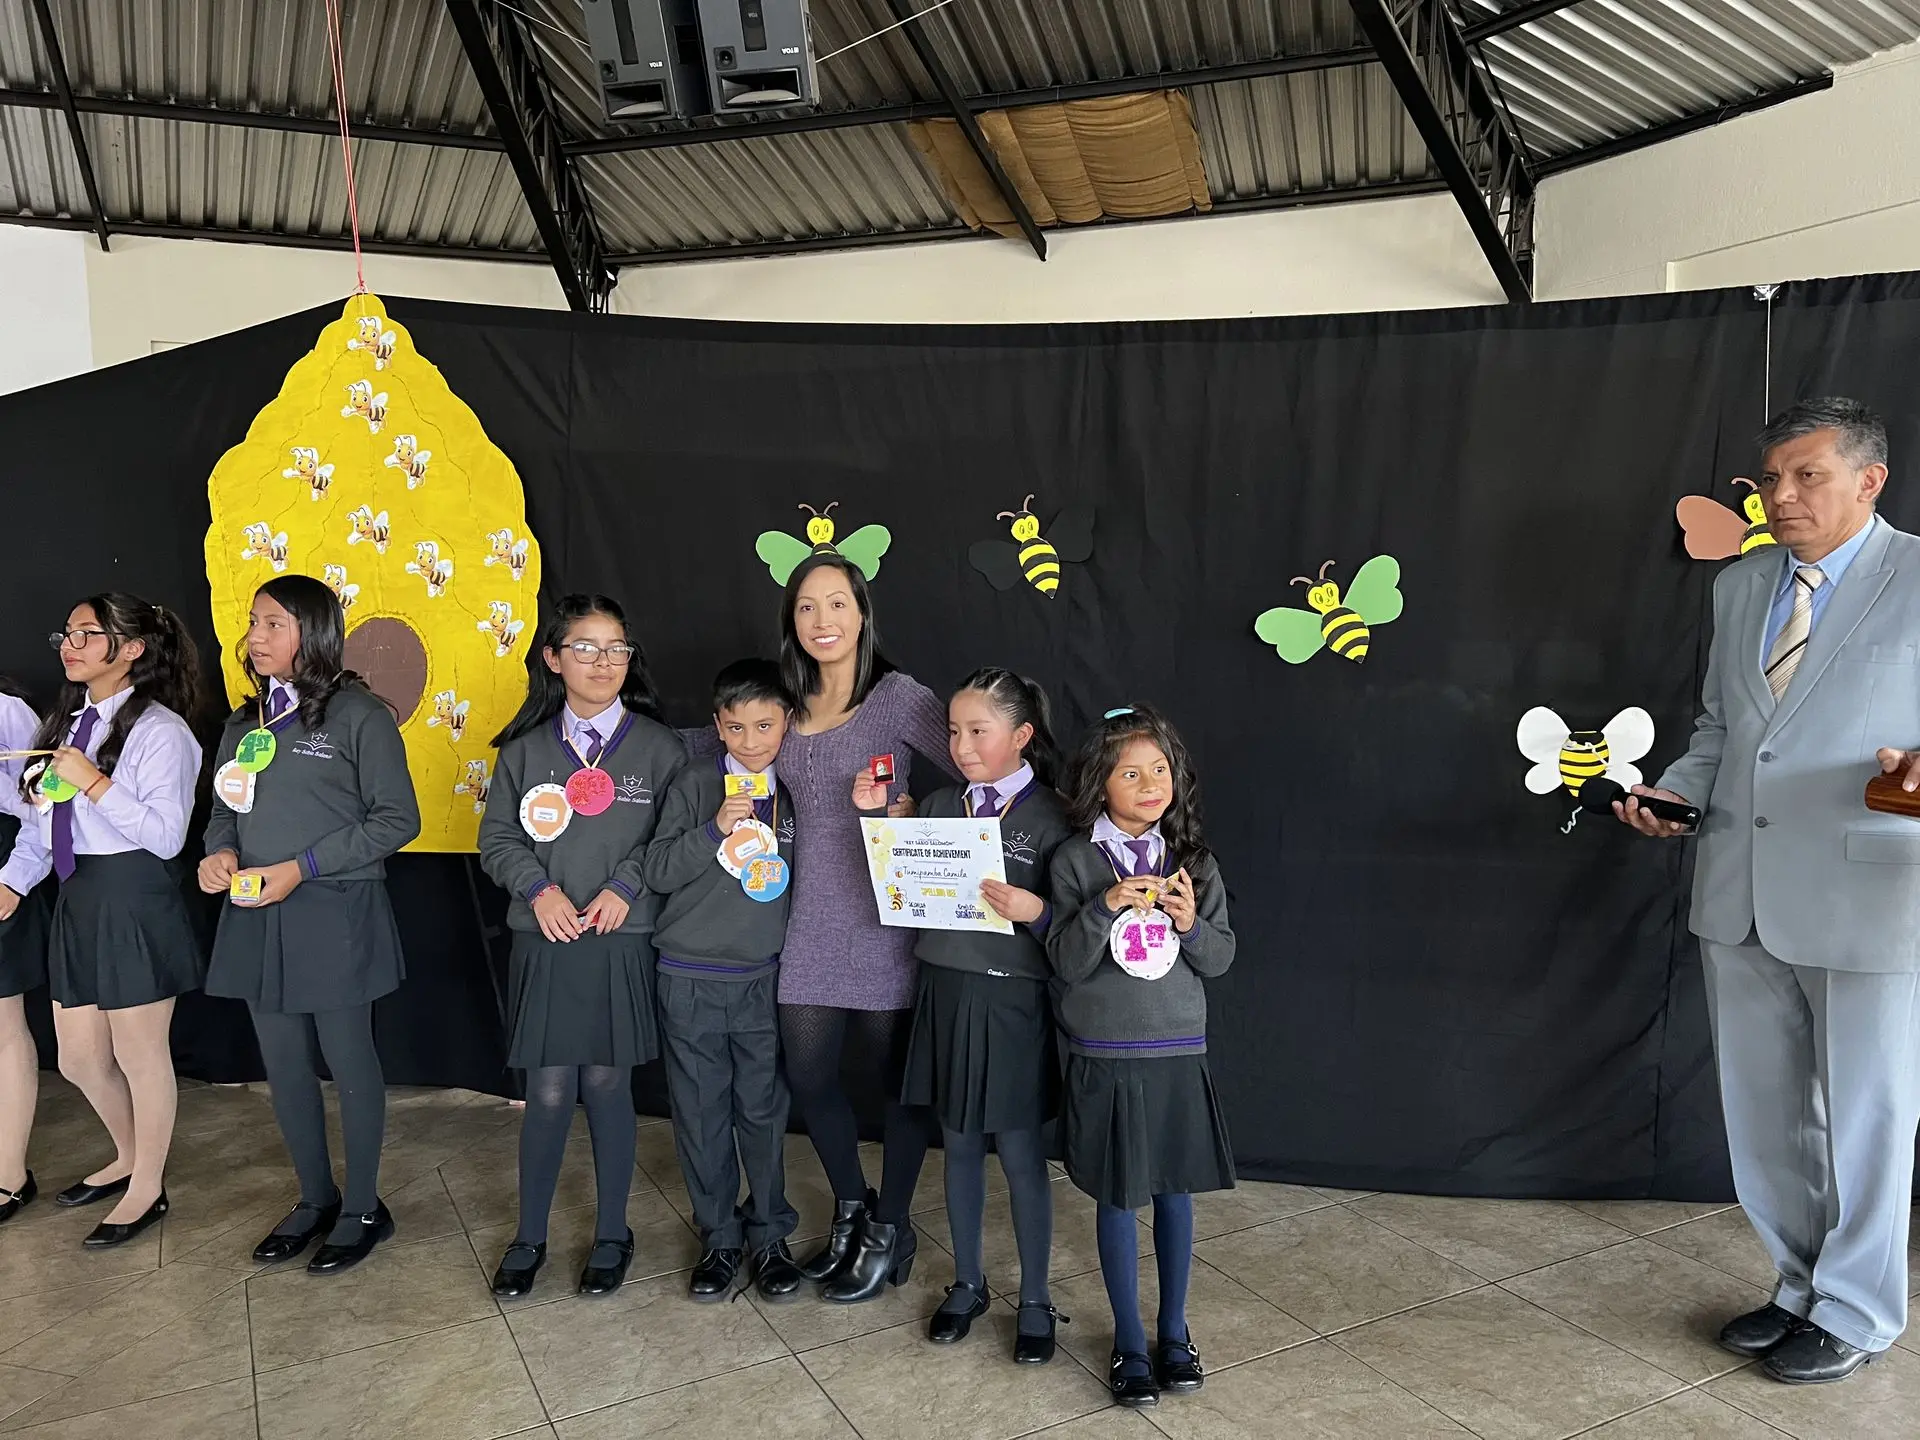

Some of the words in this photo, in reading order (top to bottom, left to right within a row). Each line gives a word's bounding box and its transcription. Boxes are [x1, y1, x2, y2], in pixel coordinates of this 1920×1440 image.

[892, 848, 924, 858] CERTIFICATE
[924, 849, 932, 858] OF
[933, 849, 971, 859] ACHIEVEMENT
[943, 867, 968, 879] Camila
[911, 908, 926, 918] DATE
[955, 910, 987, 921] SIGNATURE
